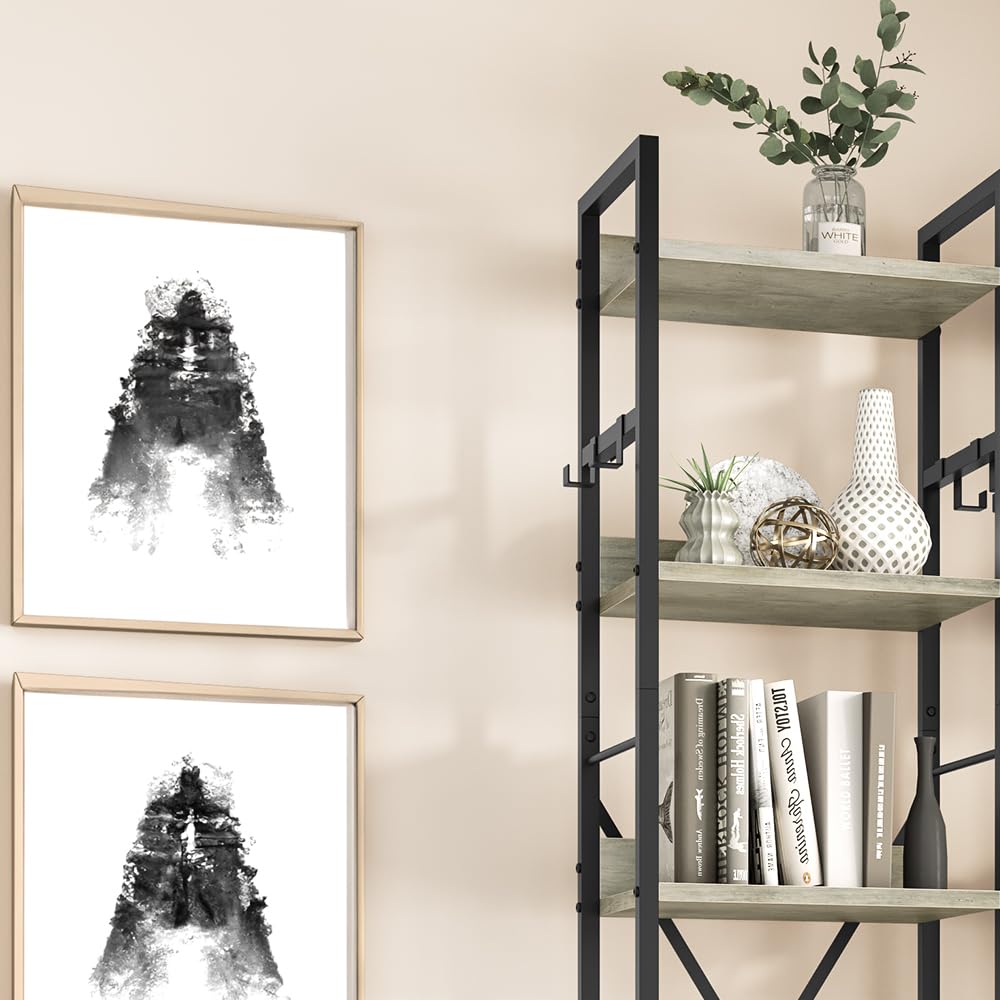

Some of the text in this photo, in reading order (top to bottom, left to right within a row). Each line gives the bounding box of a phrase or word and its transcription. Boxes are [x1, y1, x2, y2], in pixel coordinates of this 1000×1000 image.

[821, 231, 859, 242] WHITE
[839, 748, 852, 831] WORLD BALLET
